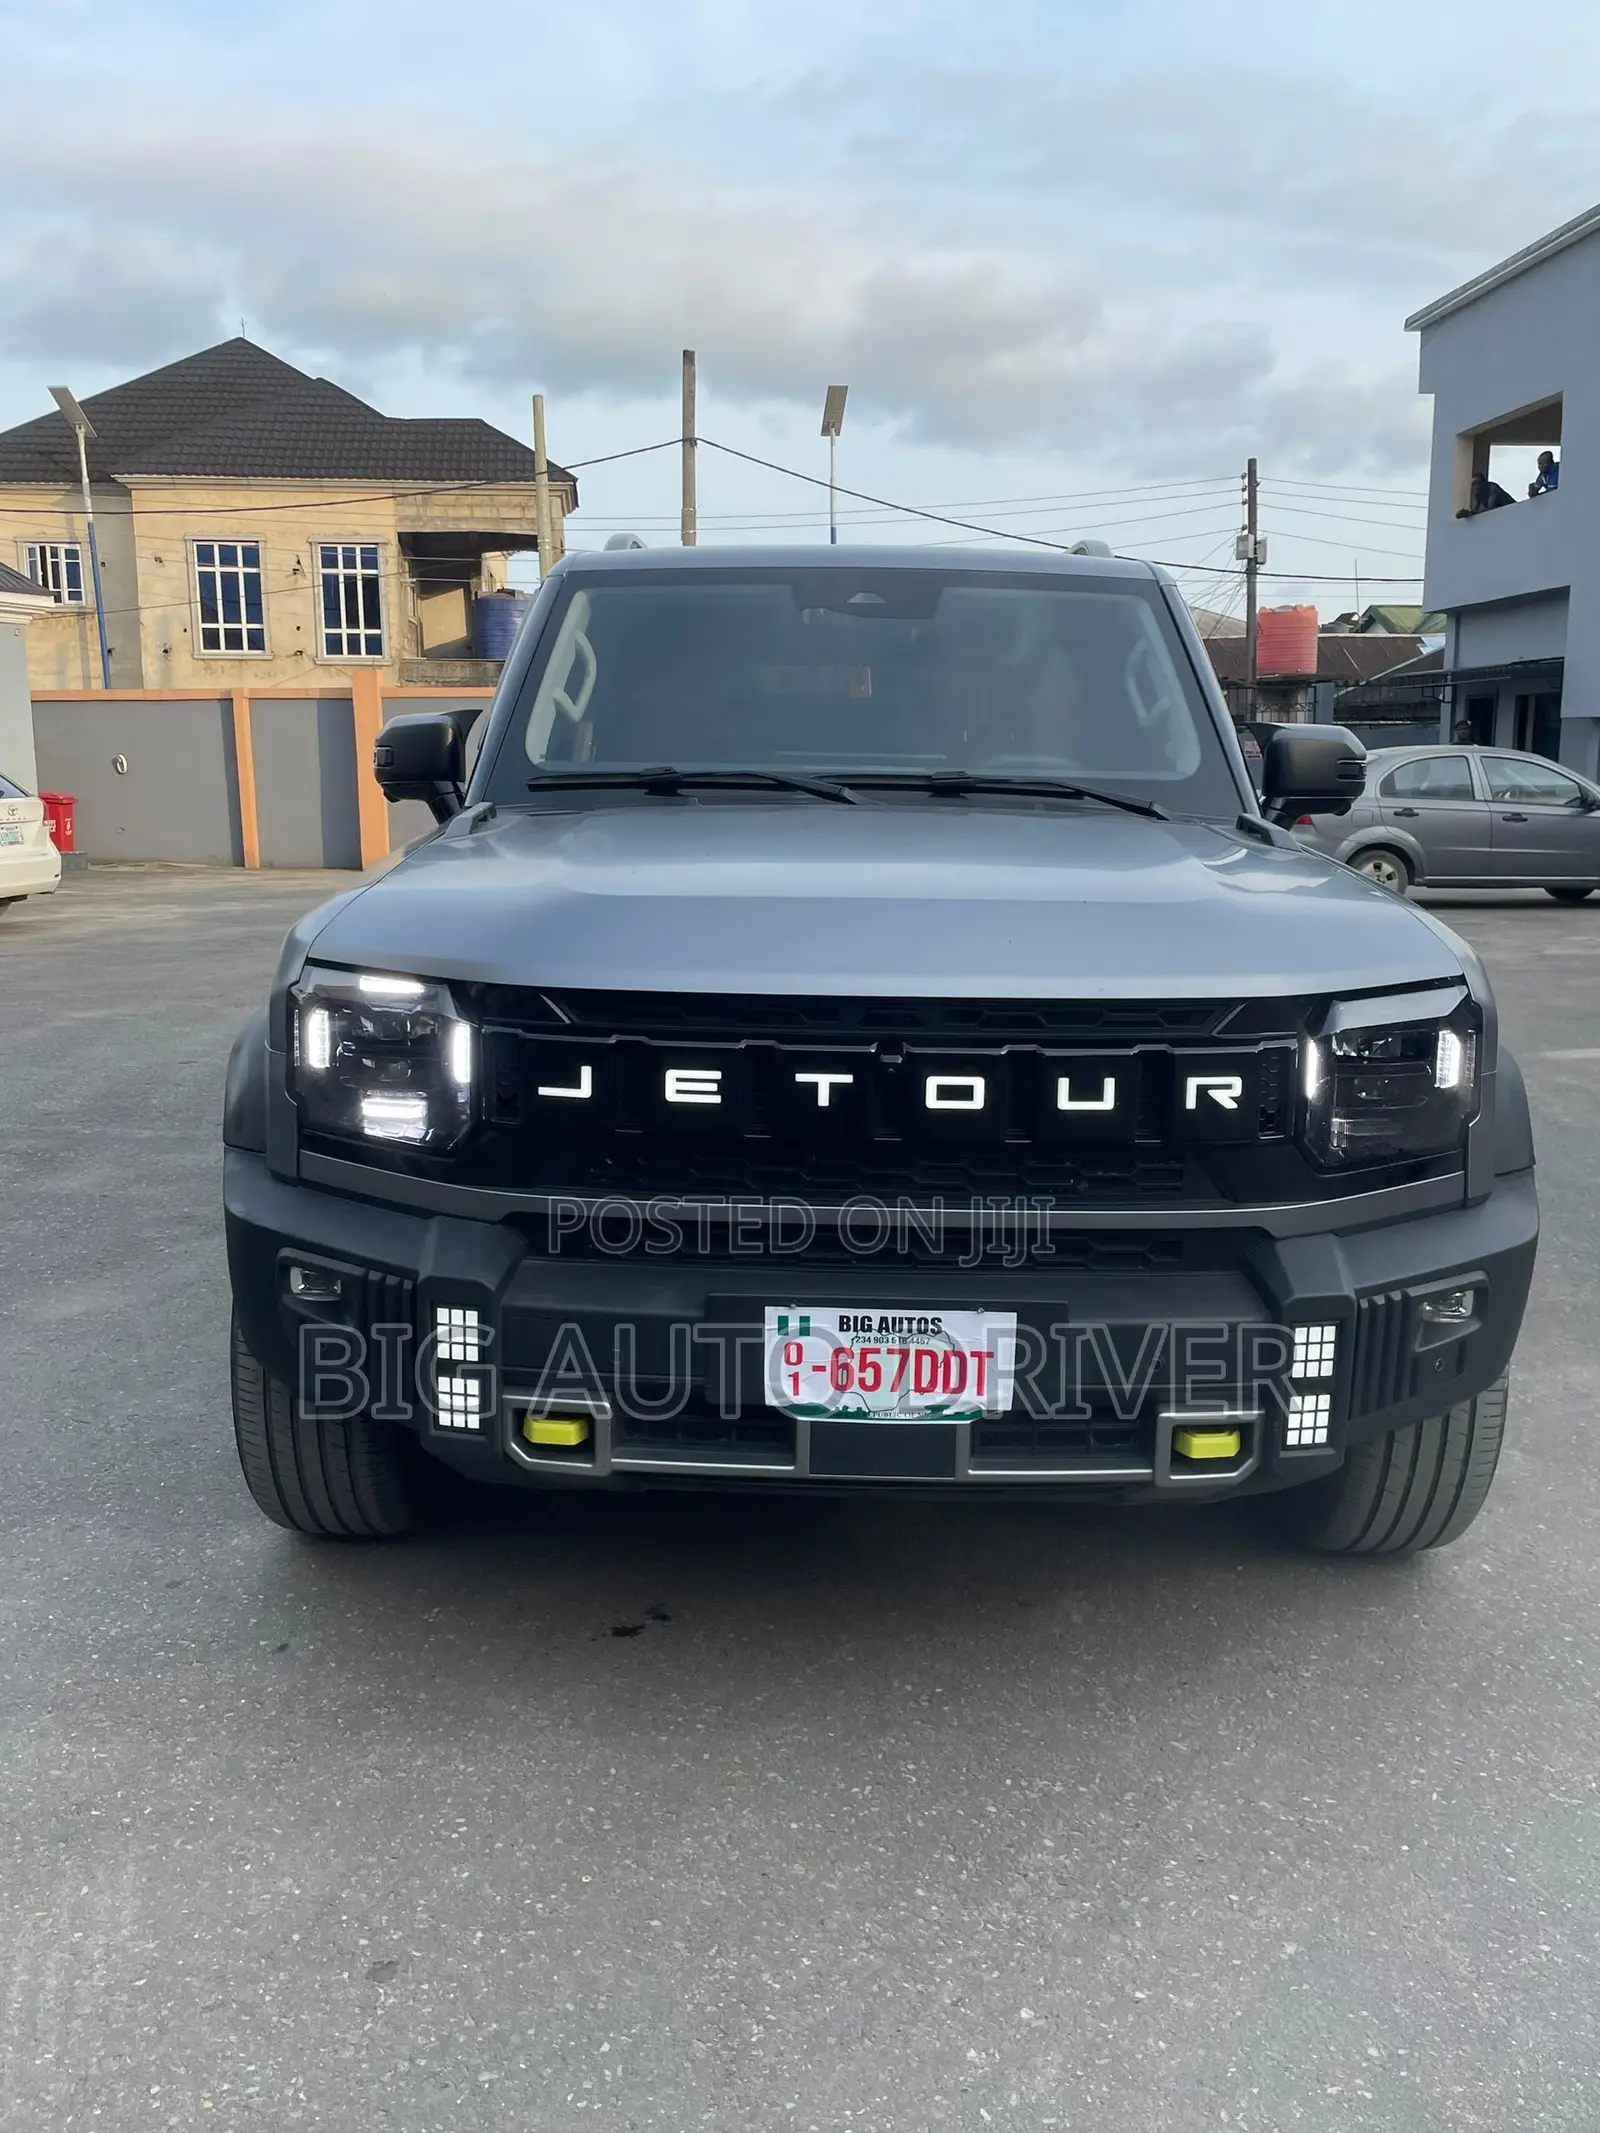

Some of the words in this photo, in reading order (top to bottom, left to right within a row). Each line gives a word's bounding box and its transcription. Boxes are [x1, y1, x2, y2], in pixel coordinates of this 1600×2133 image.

[537, 1065, 1243, 1110] JETOUR
[838, 1314, 873, 1333] BIG
[877, 1316, 942, 1335] AUTOS
[873, 1336, 889, 1345] 903
